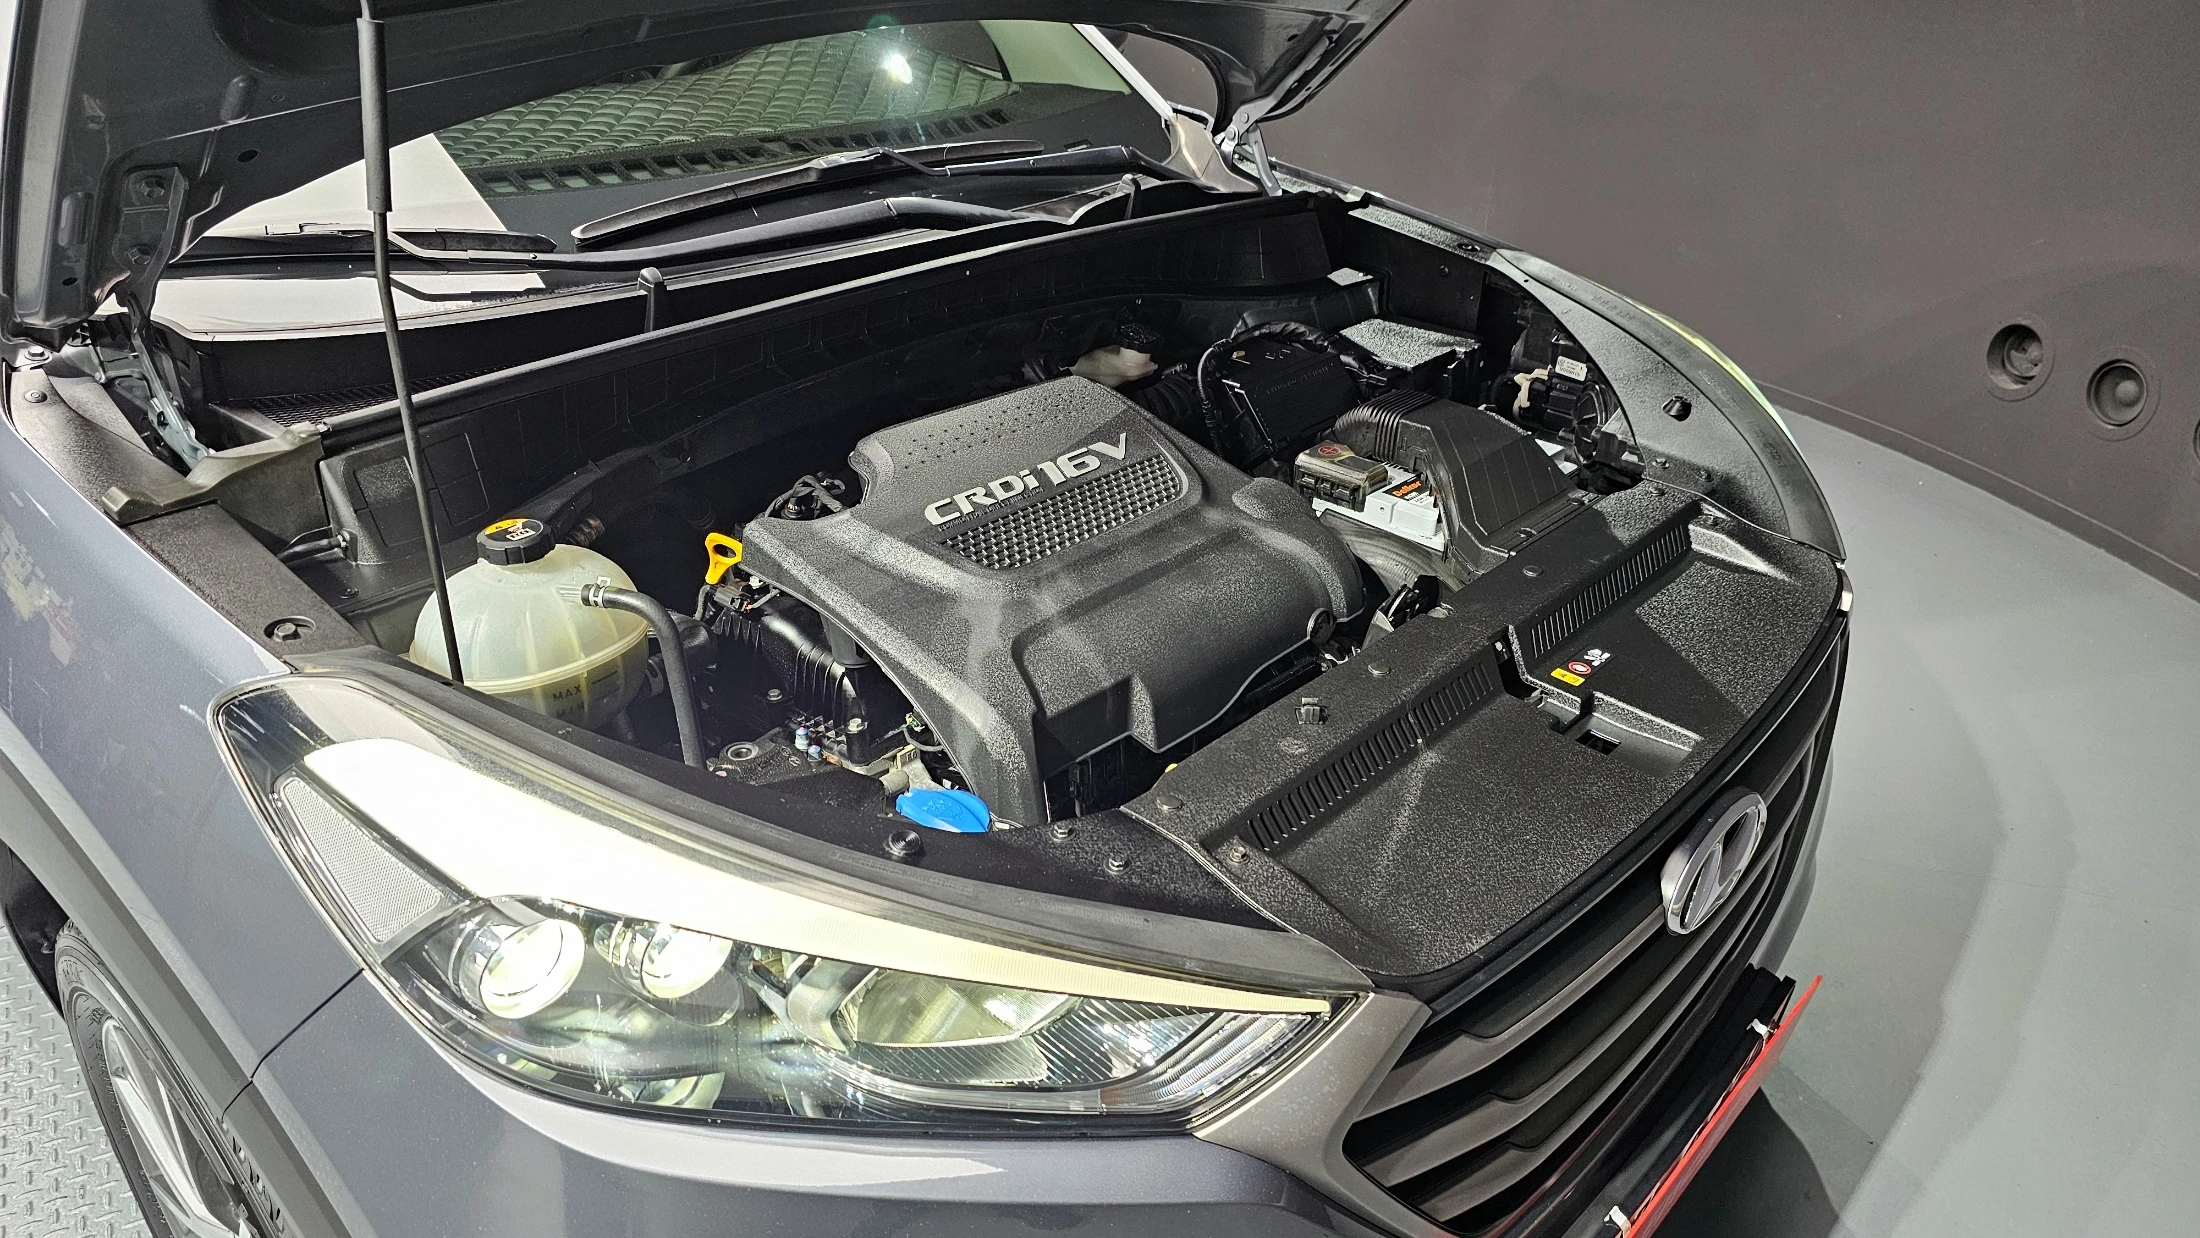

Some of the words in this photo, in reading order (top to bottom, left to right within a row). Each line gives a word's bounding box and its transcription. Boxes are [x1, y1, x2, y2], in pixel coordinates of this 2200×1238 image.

[924, 469, 1039, 525] CRDi
[1037, 433, 1126, 486] 16V
[552, 684, 582, 700] MAX
